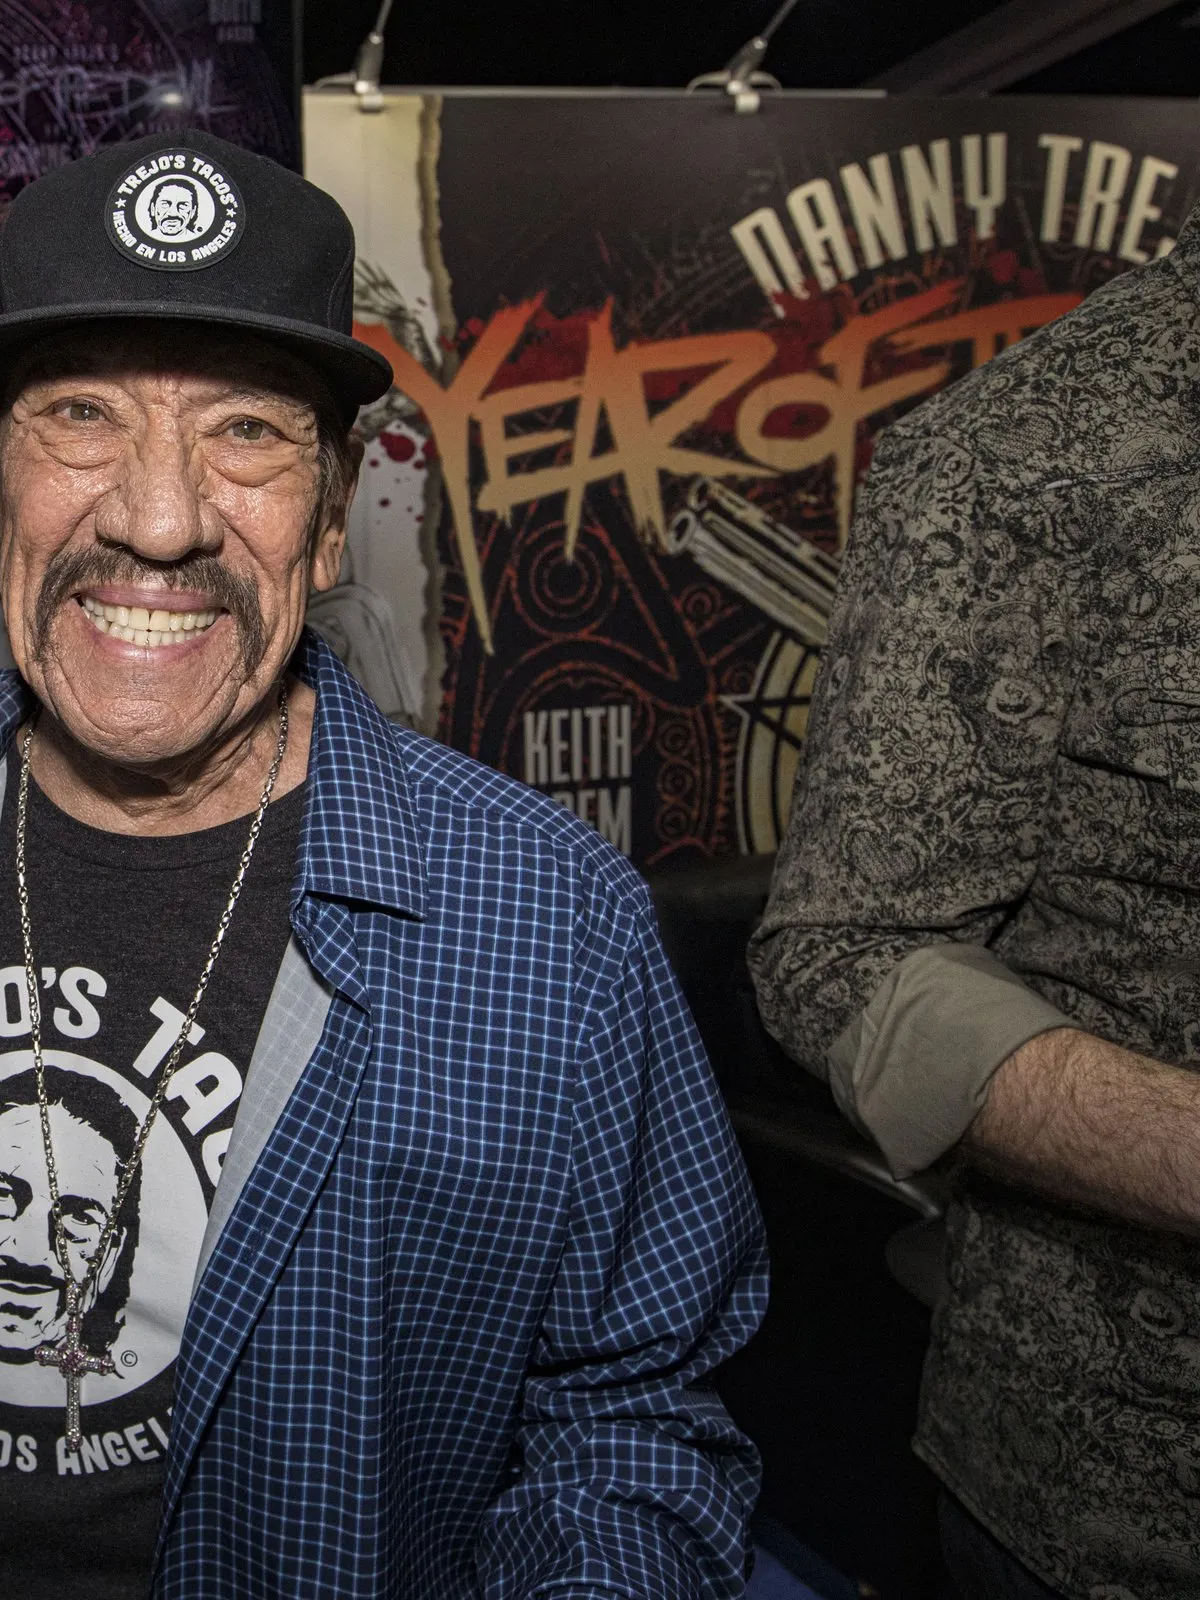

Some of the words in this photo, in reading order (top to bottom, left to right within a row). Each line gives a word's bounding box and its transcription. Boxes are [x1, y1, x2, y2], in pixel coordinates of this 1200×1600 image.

[118, 154, 186, 195] TREJO'S
[113, 211, 137, 248] HECHO
[135, 244, 156, 260] EN
[159, 250, 187, 263] LOS
[191, 220, 237, 261] ANGELES
[731, 132, 1007, 318] DANNY
[1038, 133, 1179, 264] TRE
[353, 291, 799, 656] YEAR
[523, 704, 632, 785] KEITH
